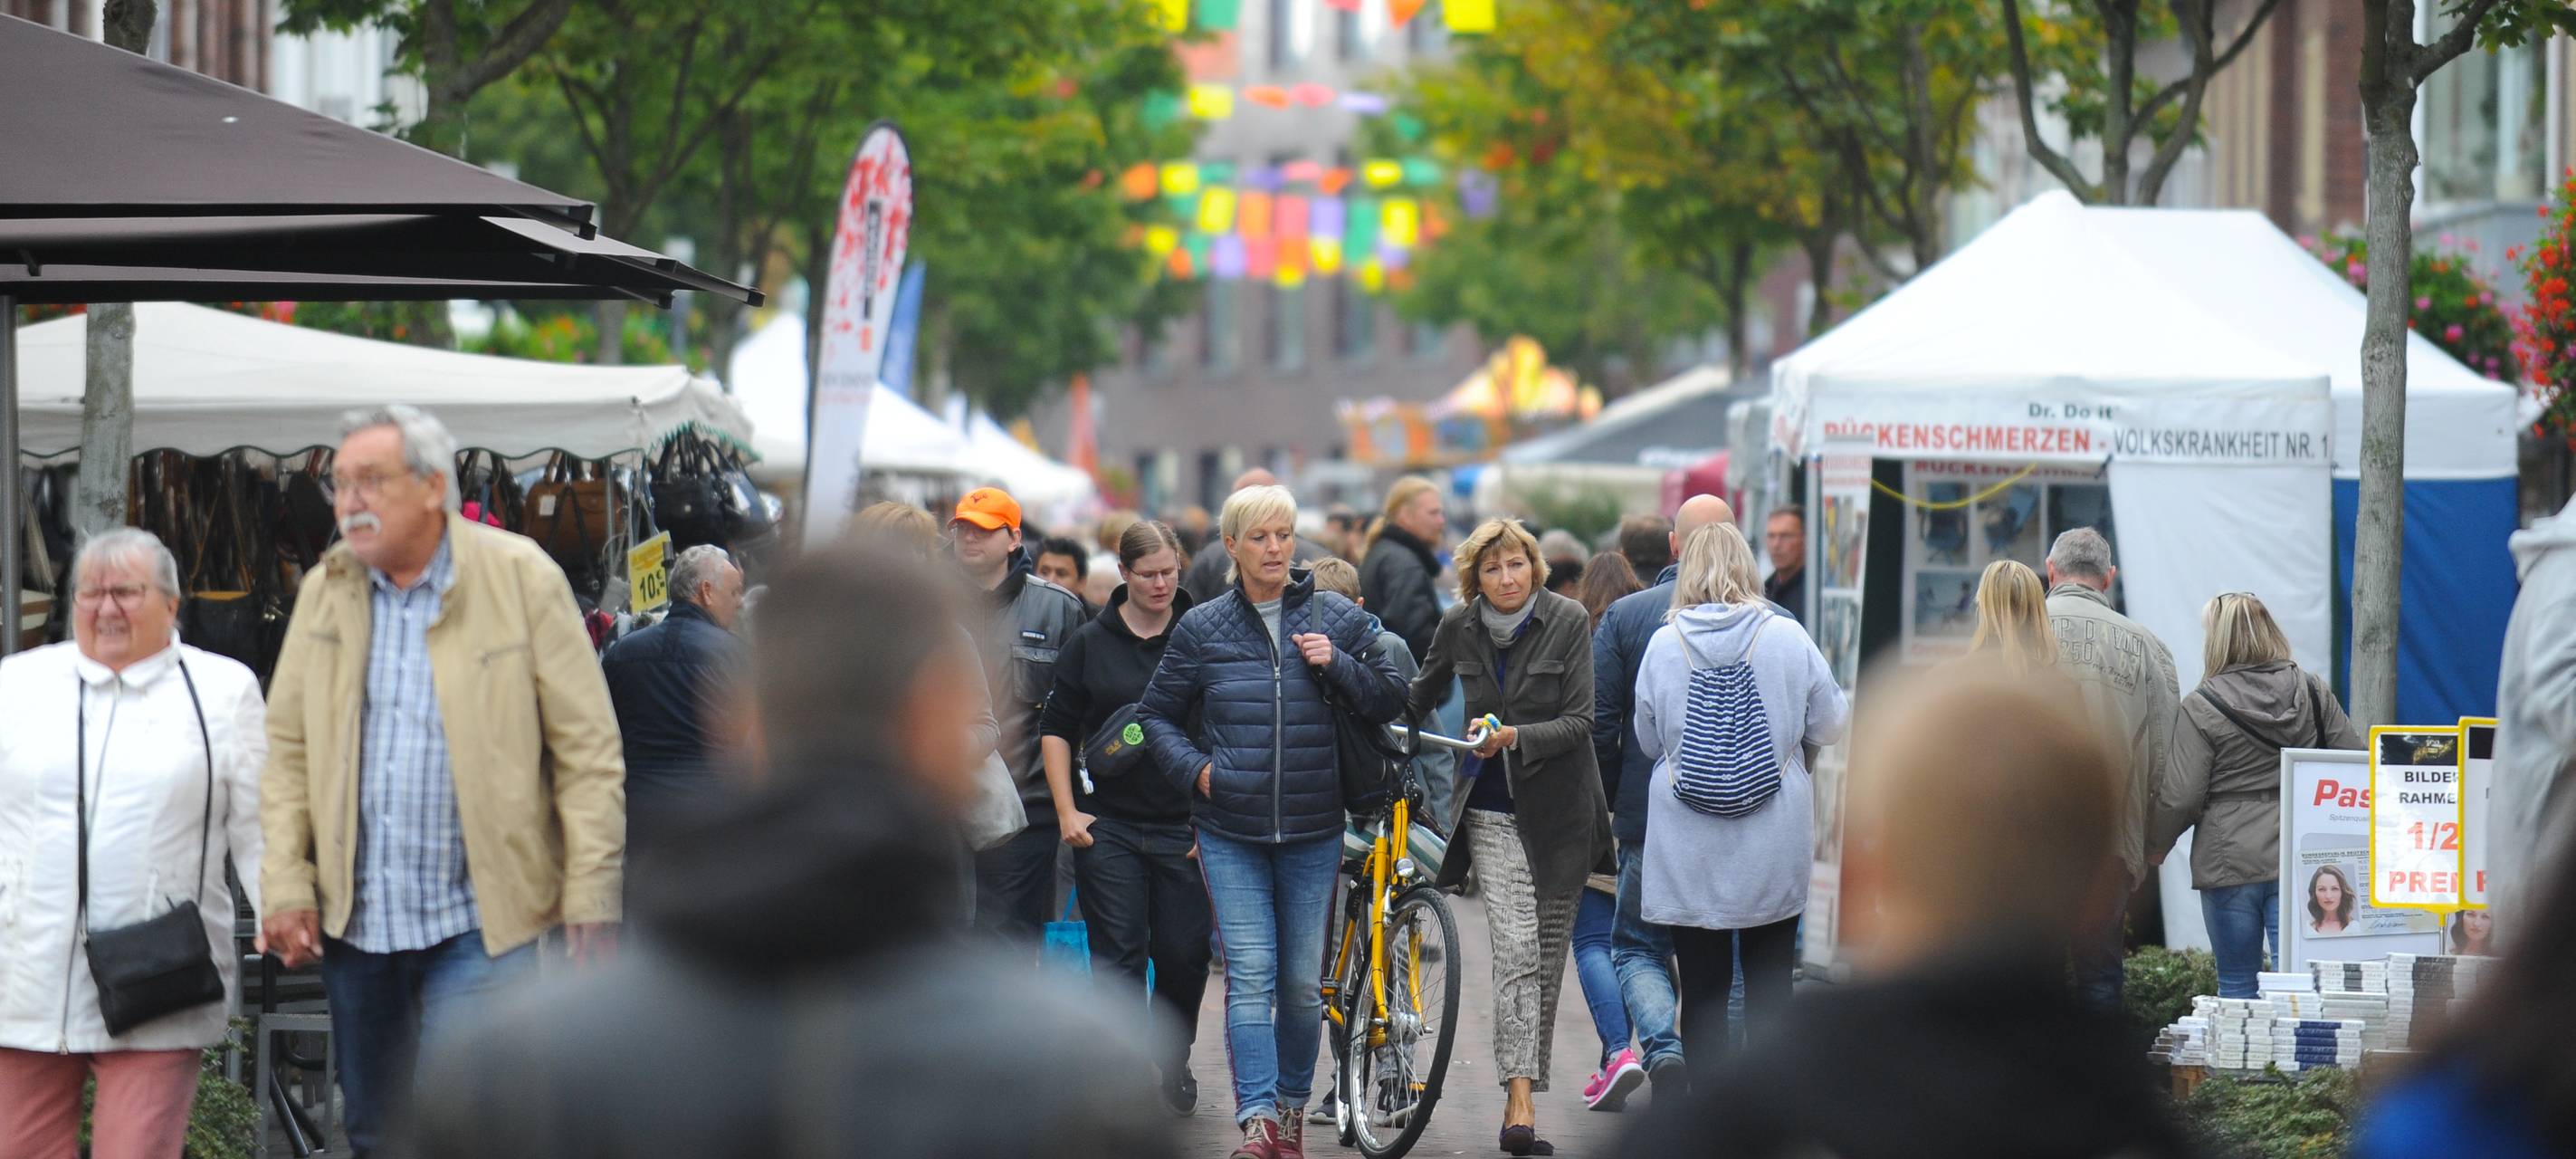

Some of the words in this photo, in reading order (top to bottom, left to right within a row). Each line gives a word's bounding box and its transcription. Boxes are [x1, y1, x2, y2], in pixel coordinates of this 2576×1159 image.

[2028, 403, 2056, 418] Dr.
[2065, 404, 2091, 419] Do
[2114, 427, 2280, 458] VOLKSKRANKHEIT
[2286, 432, 2315, 459] NR.
[2321, 434, 2328, 458] 1
[2399, 792, 2457, 804] RAHME
[2407, 821, 2458, 850] 1/2
